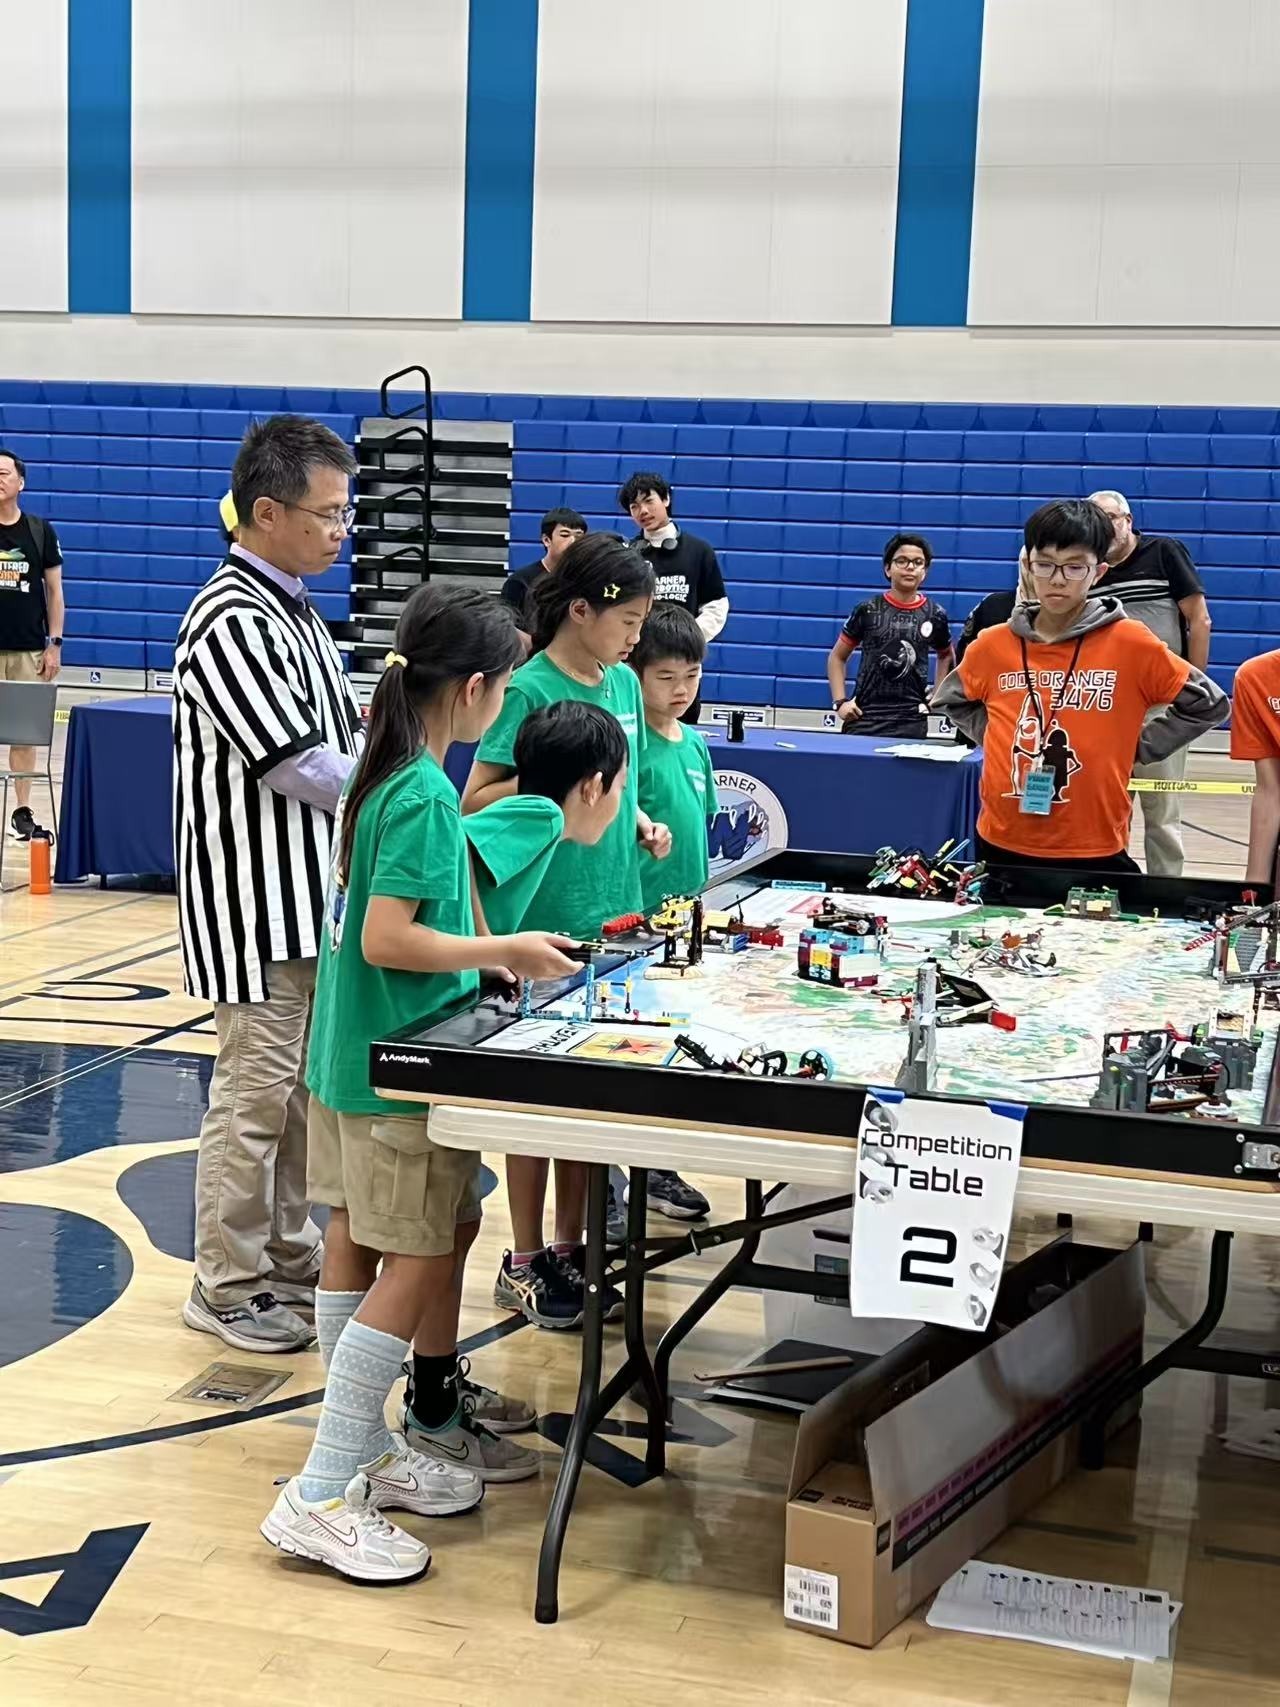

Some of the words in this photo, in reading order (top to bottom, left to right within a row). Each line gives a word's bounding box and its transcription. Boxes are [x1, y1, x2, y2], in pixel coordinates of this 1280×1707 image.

[998, 671, 1036, 692] CODE
[1039, 670, 1118, 688] ORANGE
[1050, 687, 1113, 711] 3476
[863, 1128, 1012, 1161] Competition
[884, 1162, 984, 1197] Table
[899, 1226, 958, 1288] 2
